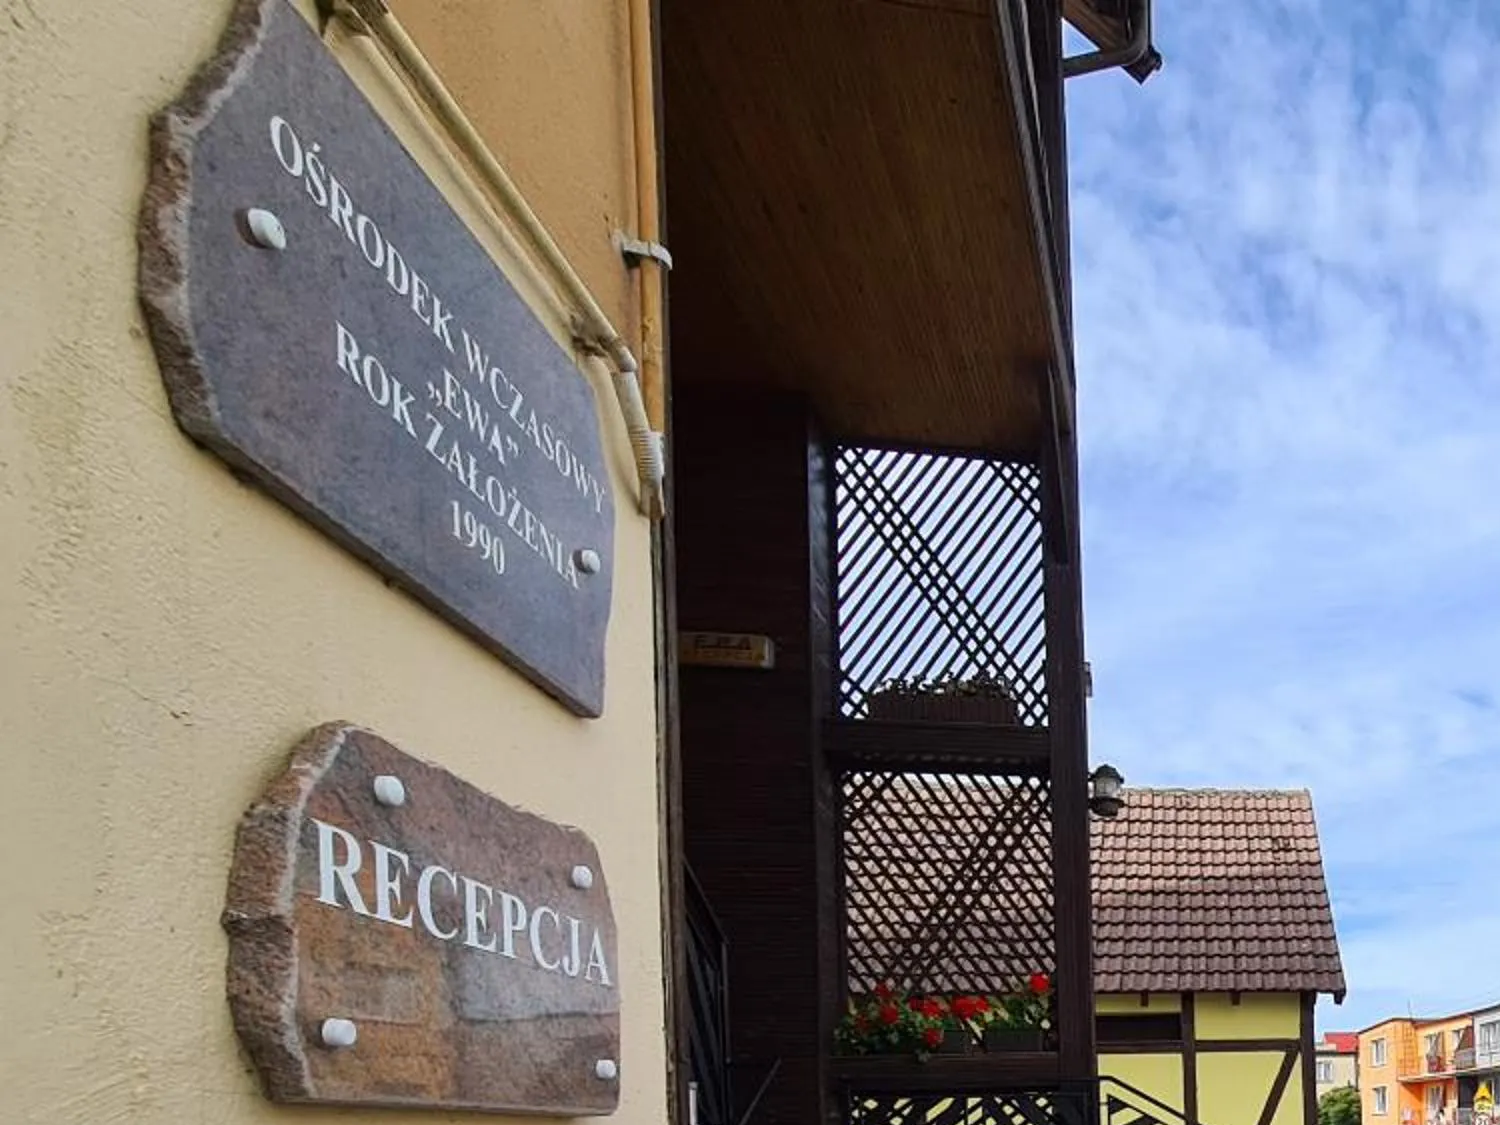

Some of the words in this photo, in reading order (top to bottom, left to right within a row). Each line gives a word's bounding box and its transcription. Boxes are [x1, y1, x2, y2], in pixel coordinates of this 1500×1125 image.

[270, 116, 456, 354] OŚRODEK
[461, 328, 606, 513] WCZASOWY
[336, 320, 418, 440] ROK
[425, 412, 579, 589] ZAŁOŻENIA
[452, 501, 505, 575] 1990
[309, 818, 613, 987] RECEPCJA
